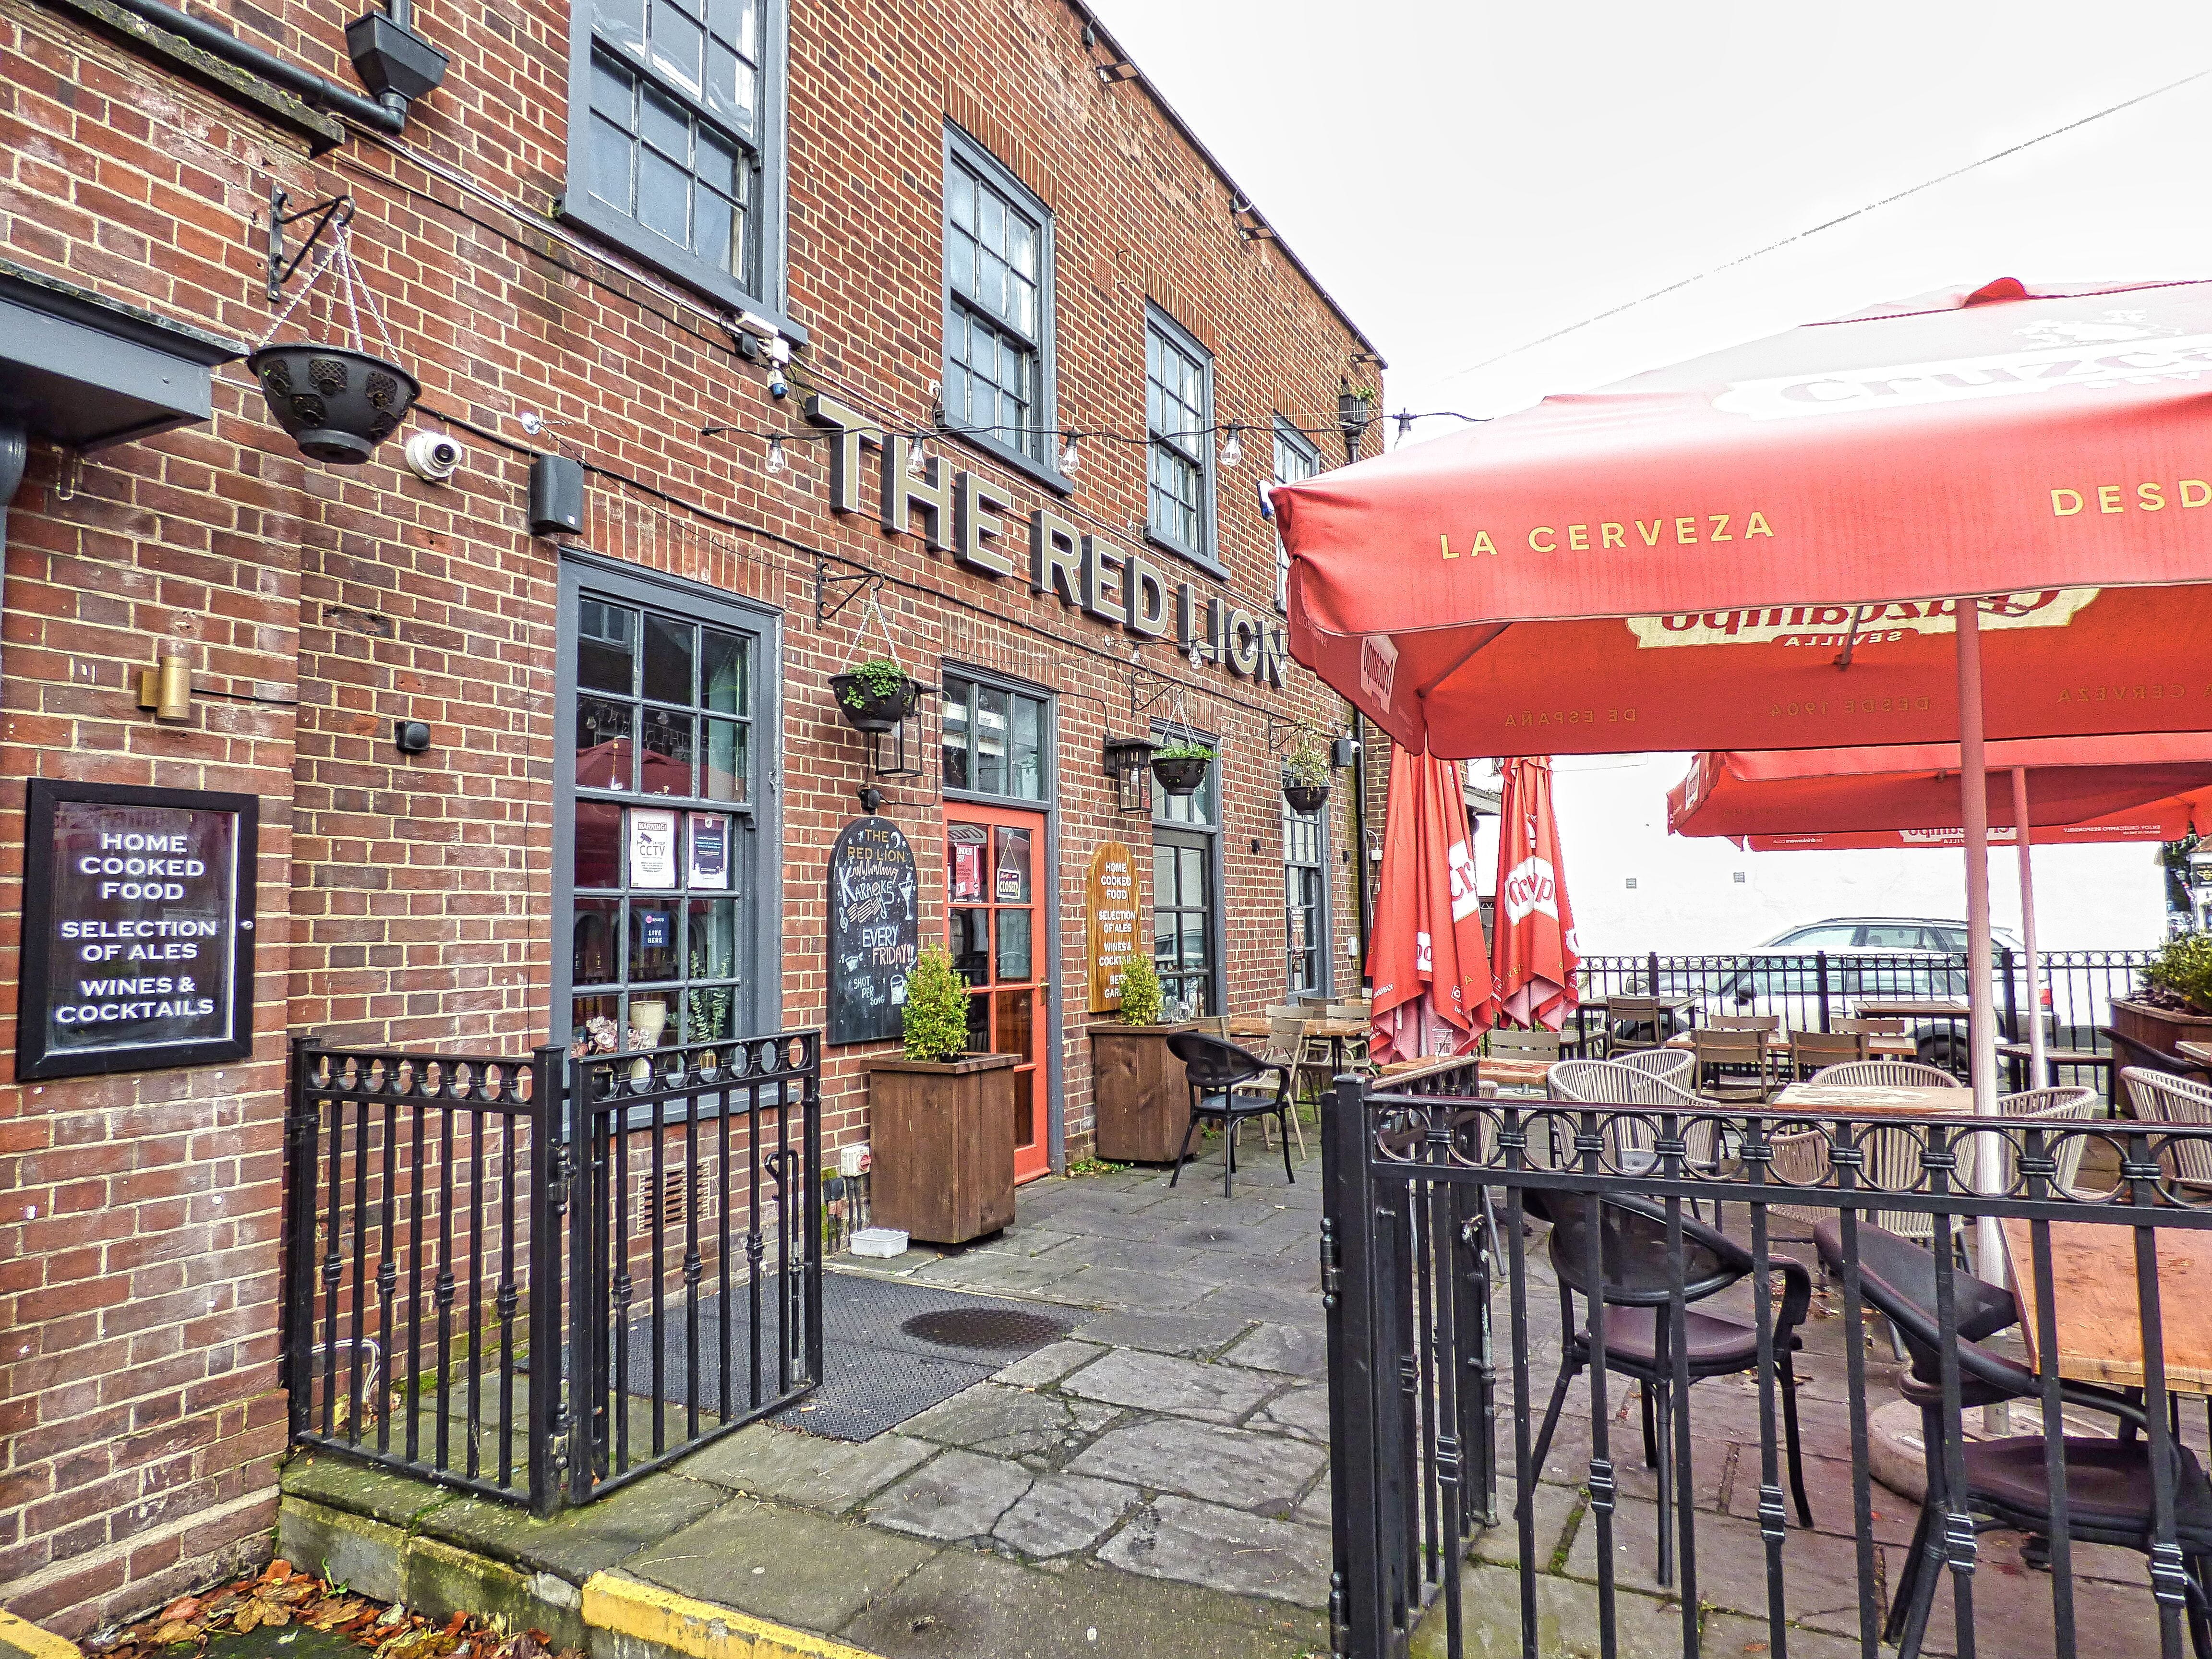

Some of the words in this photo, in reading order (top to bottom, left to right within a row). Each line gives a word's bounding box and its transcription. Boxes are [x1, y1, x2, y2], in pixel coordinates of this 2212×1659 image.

[806, 393, 1013, 577] THE
[1031, 509, 1168, 637] RED
[1178, 583, 1287, 688] LION
[1440, 530, 1497, 560] LA
[1528, 511, 1775, 553] CERVEZA
[102, 832, 188, 853] HOME
[865, 829, 889, 843] THE
[639, 845, 665, 856] CCTV
[847, 846, 873, 861] RED
[877, 849, 906, 863] LION
[80, 856, 205, 877] COOKED
[1105, 862, 1127, 873] HOME
[999, 880, 1018, 893] CLOSED
[1101, 875, 1132, 887] COOKED
[101, 882, 184, 901] FOOD
[1106, 889, 1128, 900] FOOD
[1098, 911, 1136, 921] SELECTION
[61, 920, 217, 938] SELECTION
[1103, 923, 1114, 933] OF
[1115, 923, 1132, 933] ALES
[862, 925, 899, 949] EVERY
[82, 944, 121, 962] OF
[128, 943, 198, 961] ALES
[1104, 942, 1126, 952] WINES
[1127, 942, 1132, 951] &
[81, 977, 172, 997] WINES
[178, 977, 196, 993] &
[853, 975, 871, 990] SHOT
[861, 986, 874, 1000] PER
[870, 995, 885, 1006] SONG
[56, 998, 215, 1023] COCKTAILS
